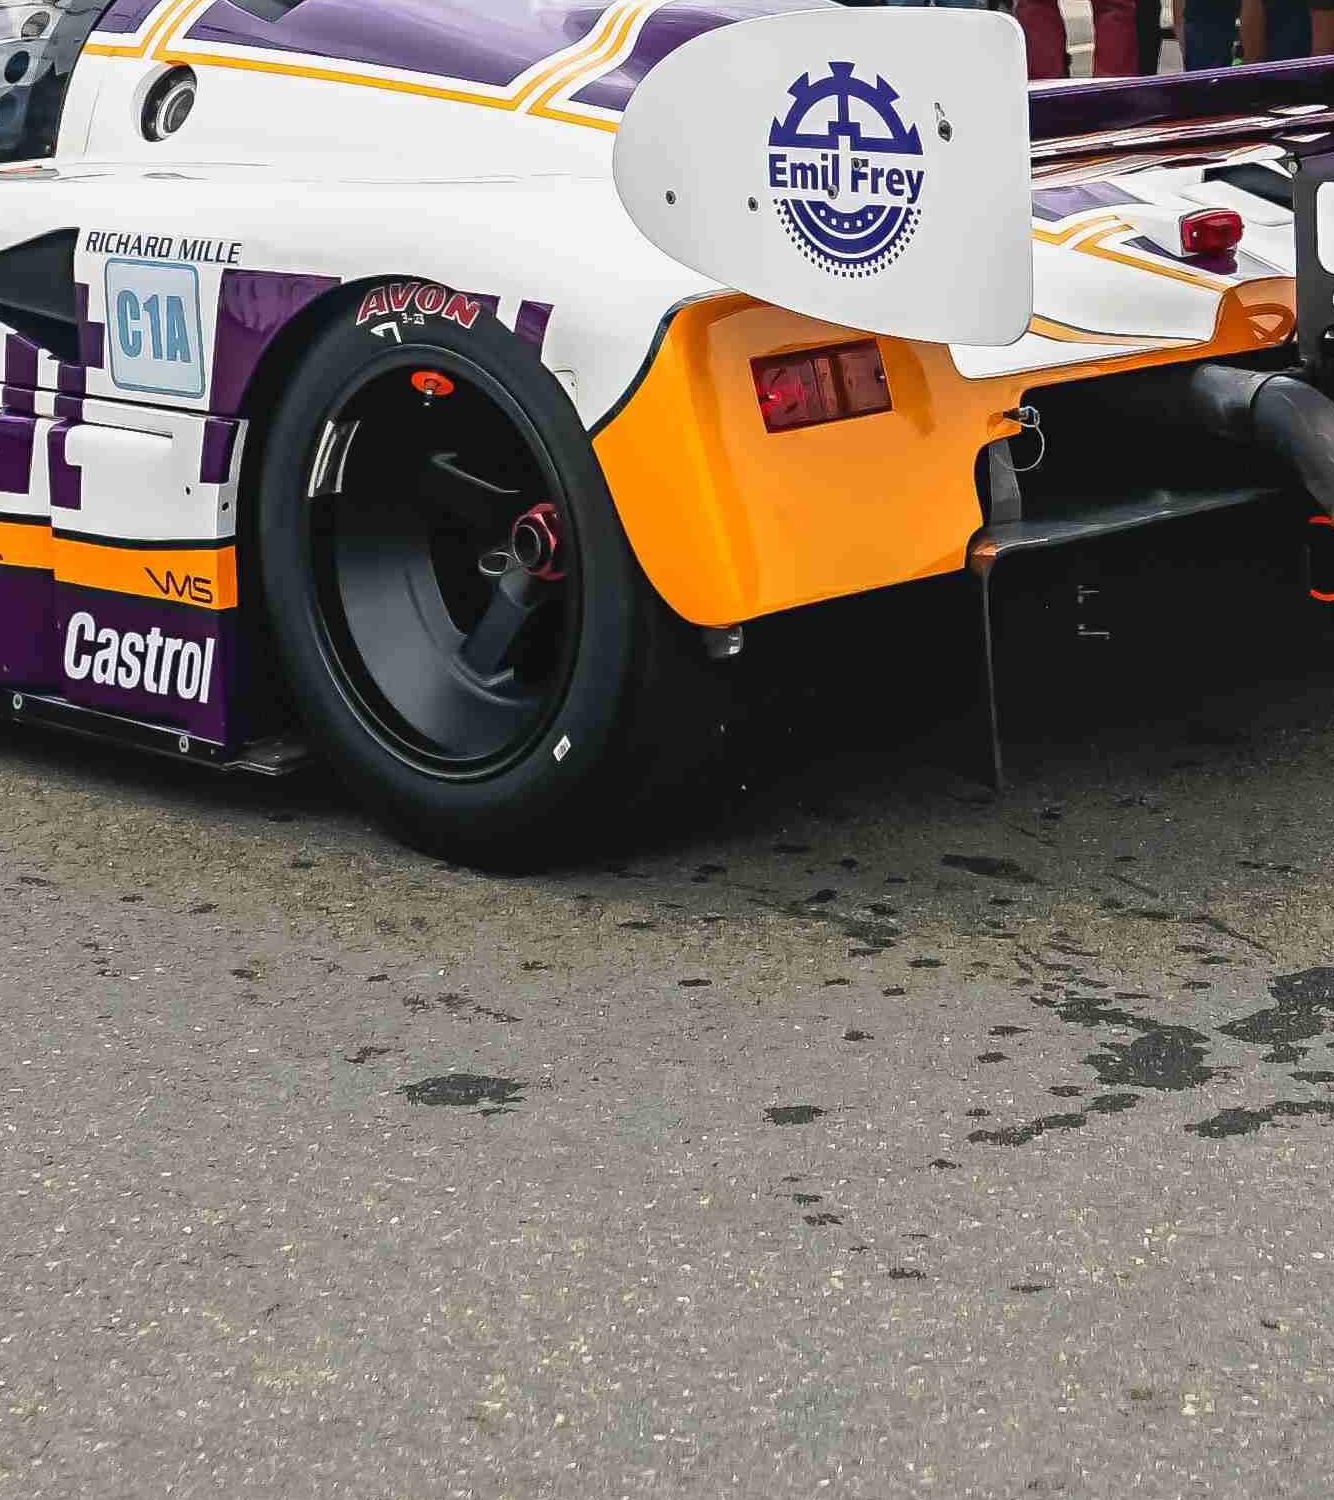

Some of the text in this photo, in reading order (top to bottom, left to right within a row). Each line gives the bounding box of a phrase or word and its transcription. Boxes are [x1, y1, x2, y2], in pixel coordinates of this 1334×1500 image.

[768, 152, 925, 206] Emil Frey
[85, 231, 242, 264] RICHARD MILLE
[117, 290, 192, 363] C1A
[356, 281, 481, 329] AVON
[64, 609, 215, 704] Castrol
